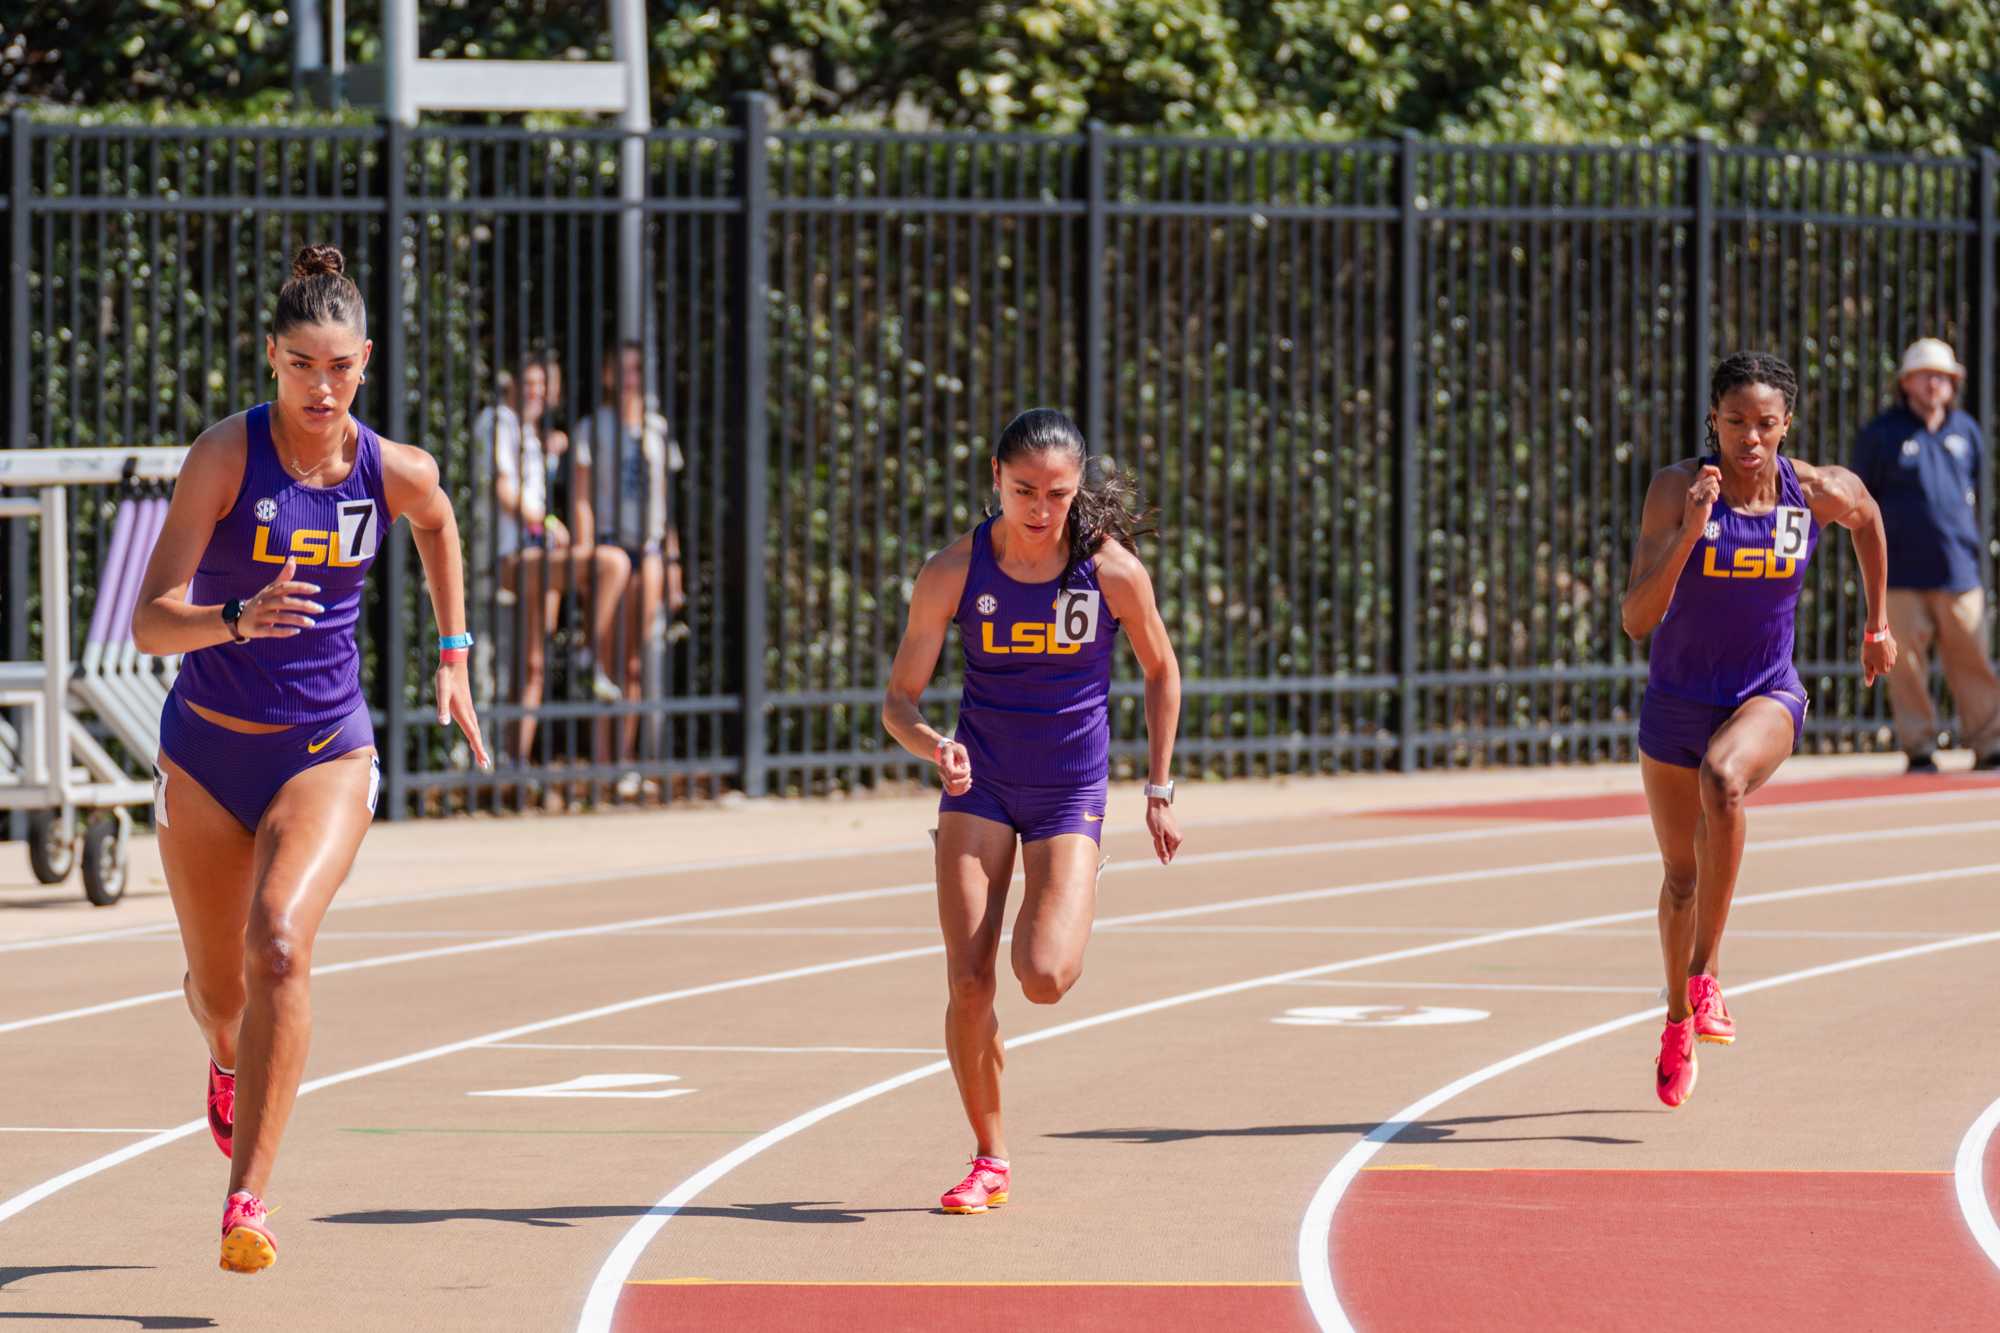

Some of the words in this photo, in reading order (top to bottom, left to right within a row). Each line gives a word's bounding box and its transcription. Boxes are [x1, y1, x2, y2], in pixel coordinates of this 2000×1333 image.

[343, 504, 373, 557] 7
[1783, 511, 1805, 554] 5
[1064, 592, 1089, 640] 6
